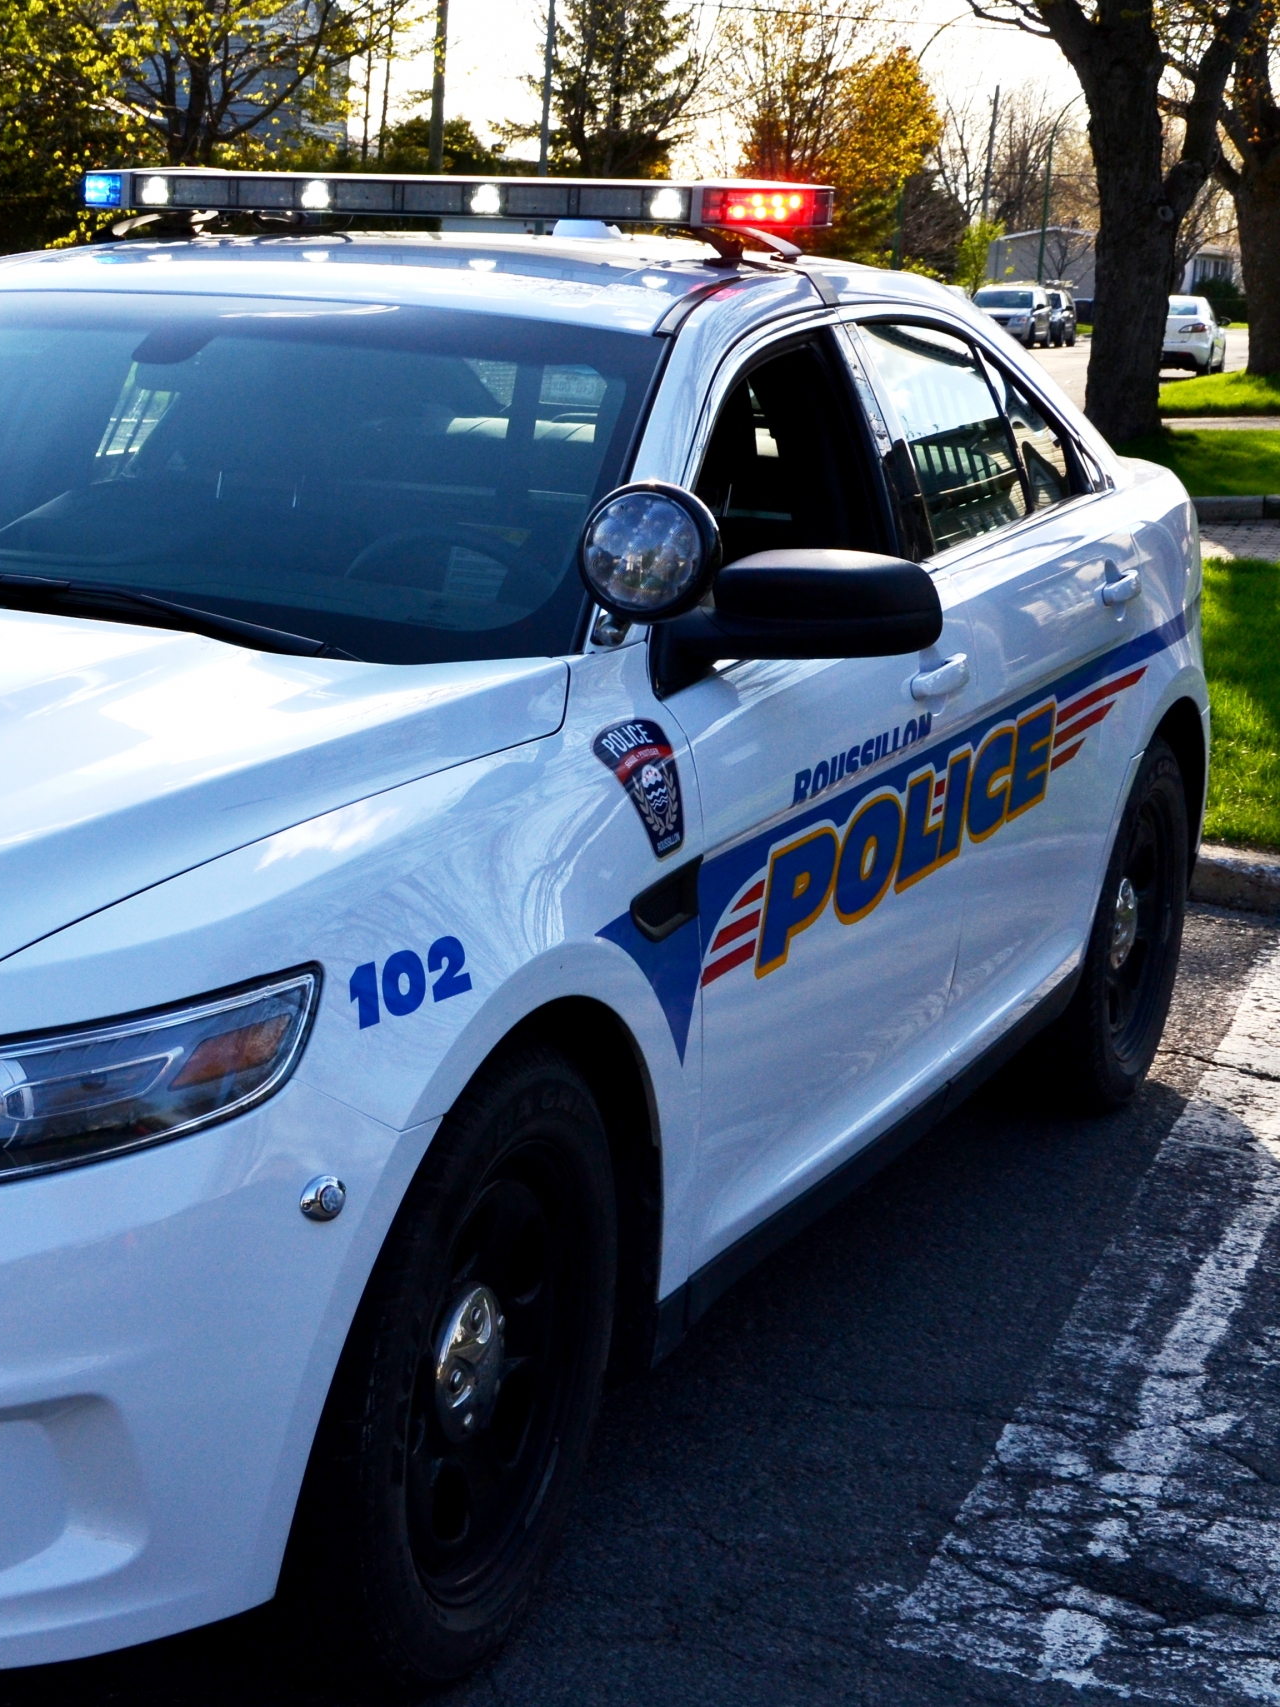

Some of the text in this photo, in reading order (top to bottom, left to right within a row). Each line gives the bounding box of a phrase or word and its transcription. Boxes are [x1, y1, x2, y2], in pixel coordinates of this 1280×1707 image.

[601, 724, 653, 758] POLICE
[790, 712, 932, 808] ROUSSILLON
[755, 701, 1056, 979] POLICE
[349, 935, 472, 1030] 102
